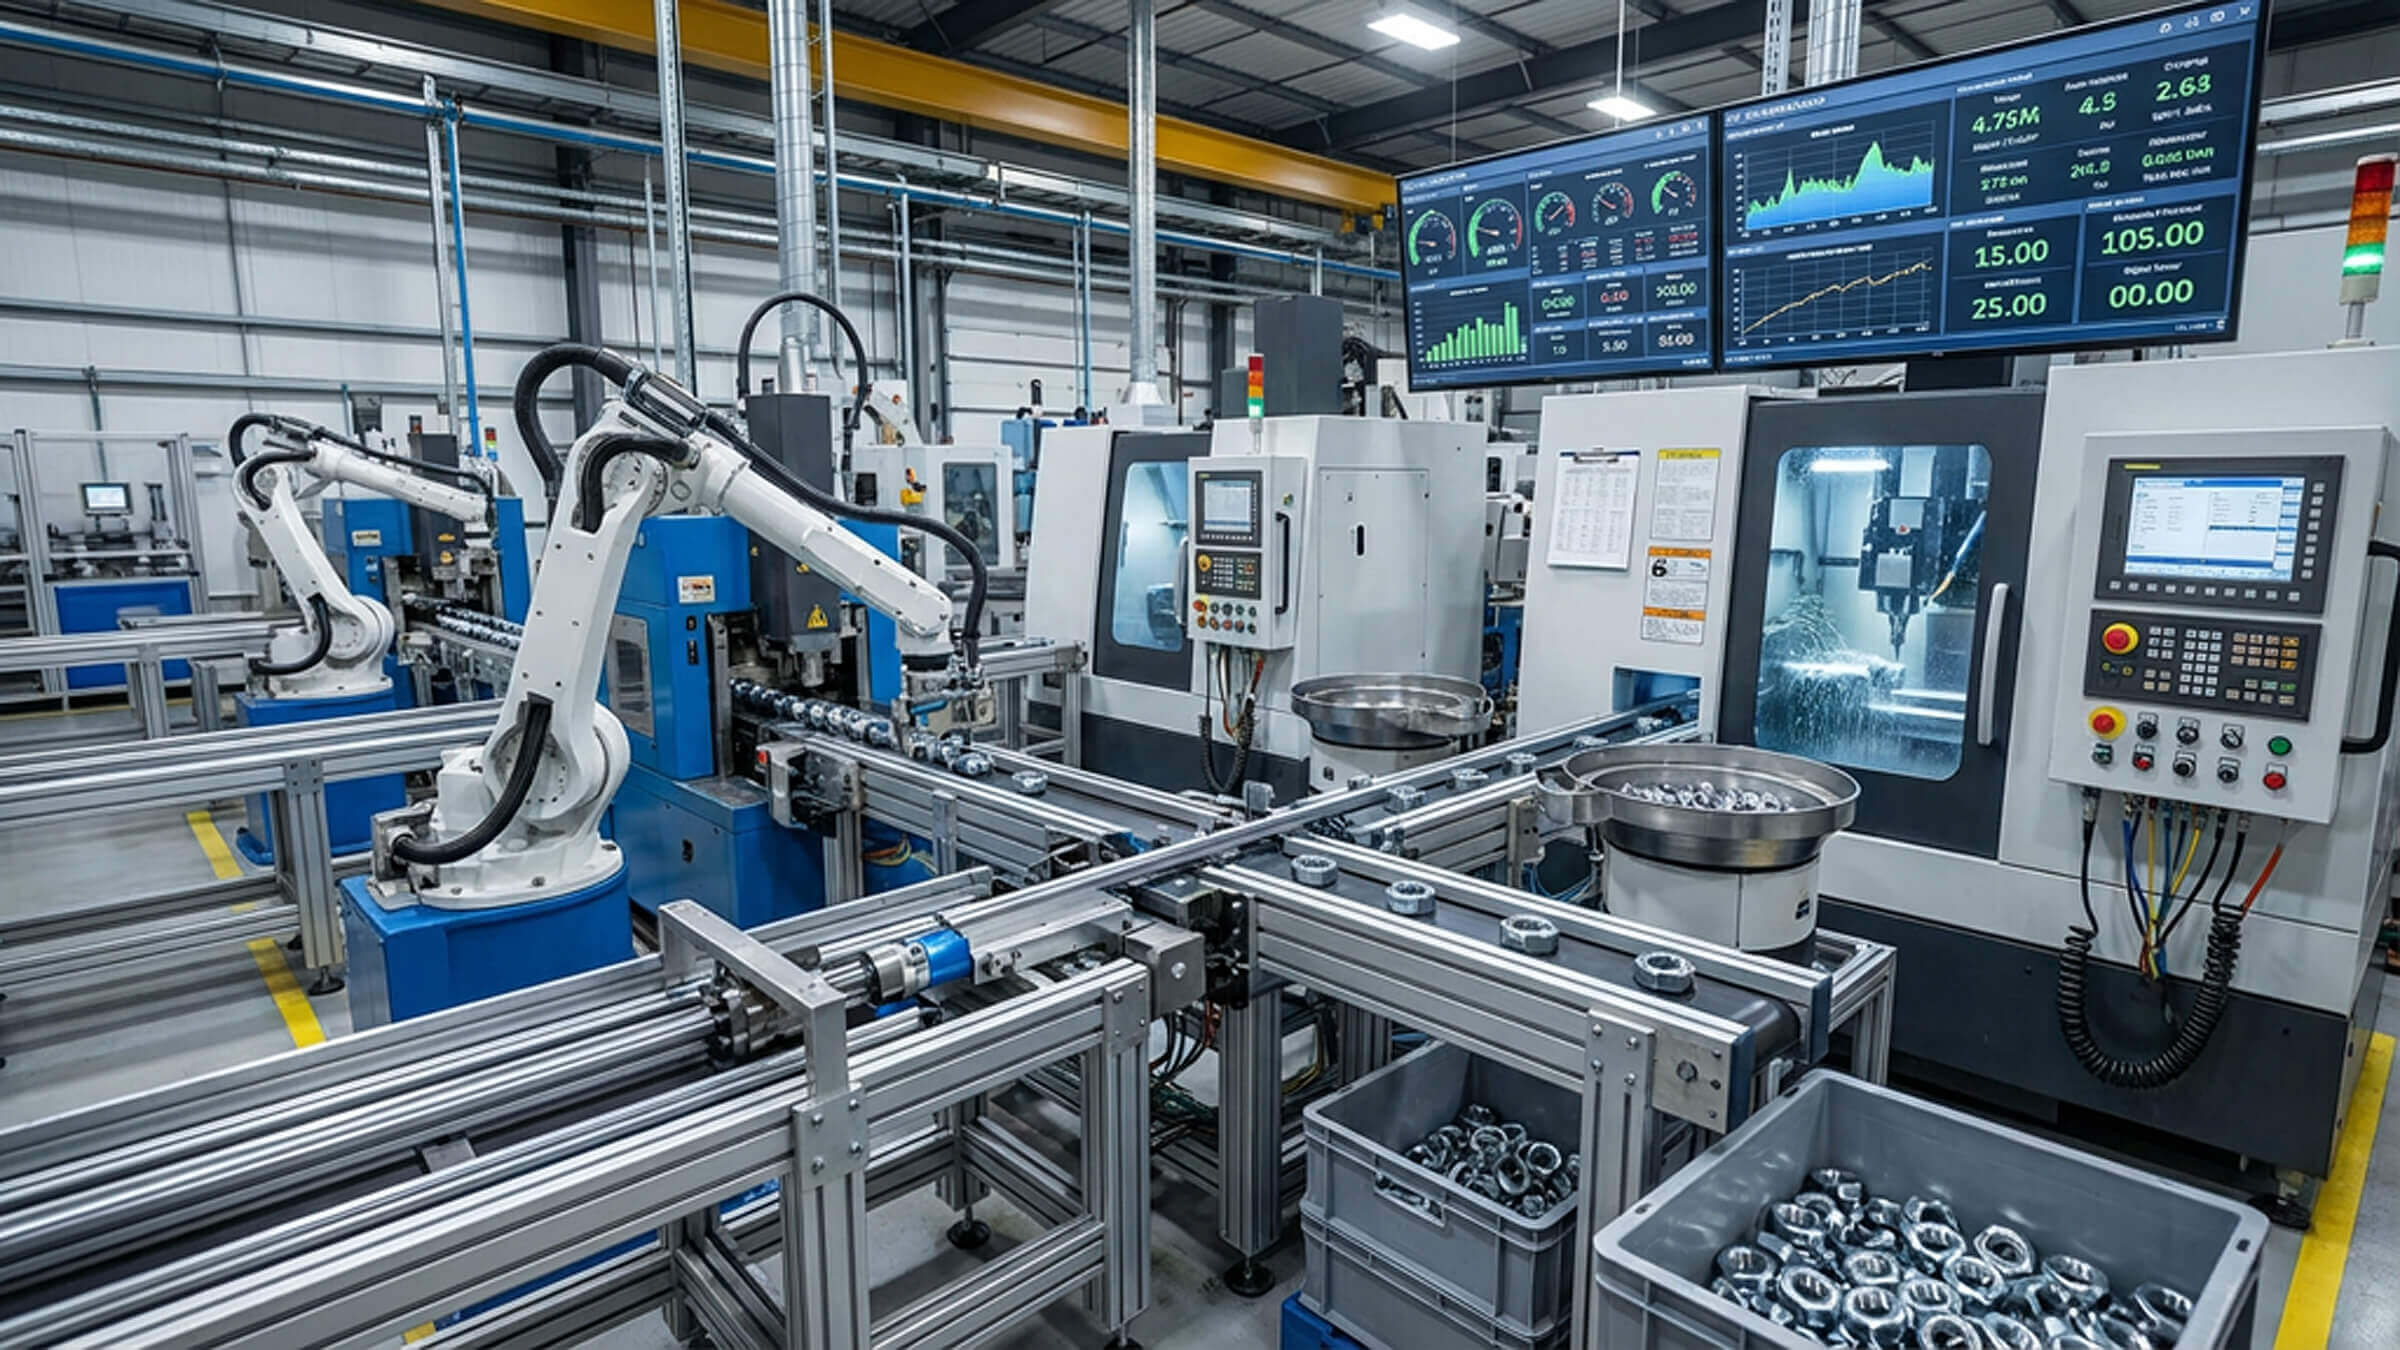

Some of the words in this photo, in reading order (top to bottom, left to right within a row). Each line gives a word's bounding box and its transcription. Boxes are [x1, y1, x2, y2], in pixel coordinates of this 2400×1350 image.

[2101, 220, 2206, 255] 105.00
[1975, 239, 2049, 268] 15.00
[1972, 292, 2047, 320] 25.00
[2109, 279, 2194, 308] 00.00
[1652, 558, 1668, 578] 6
